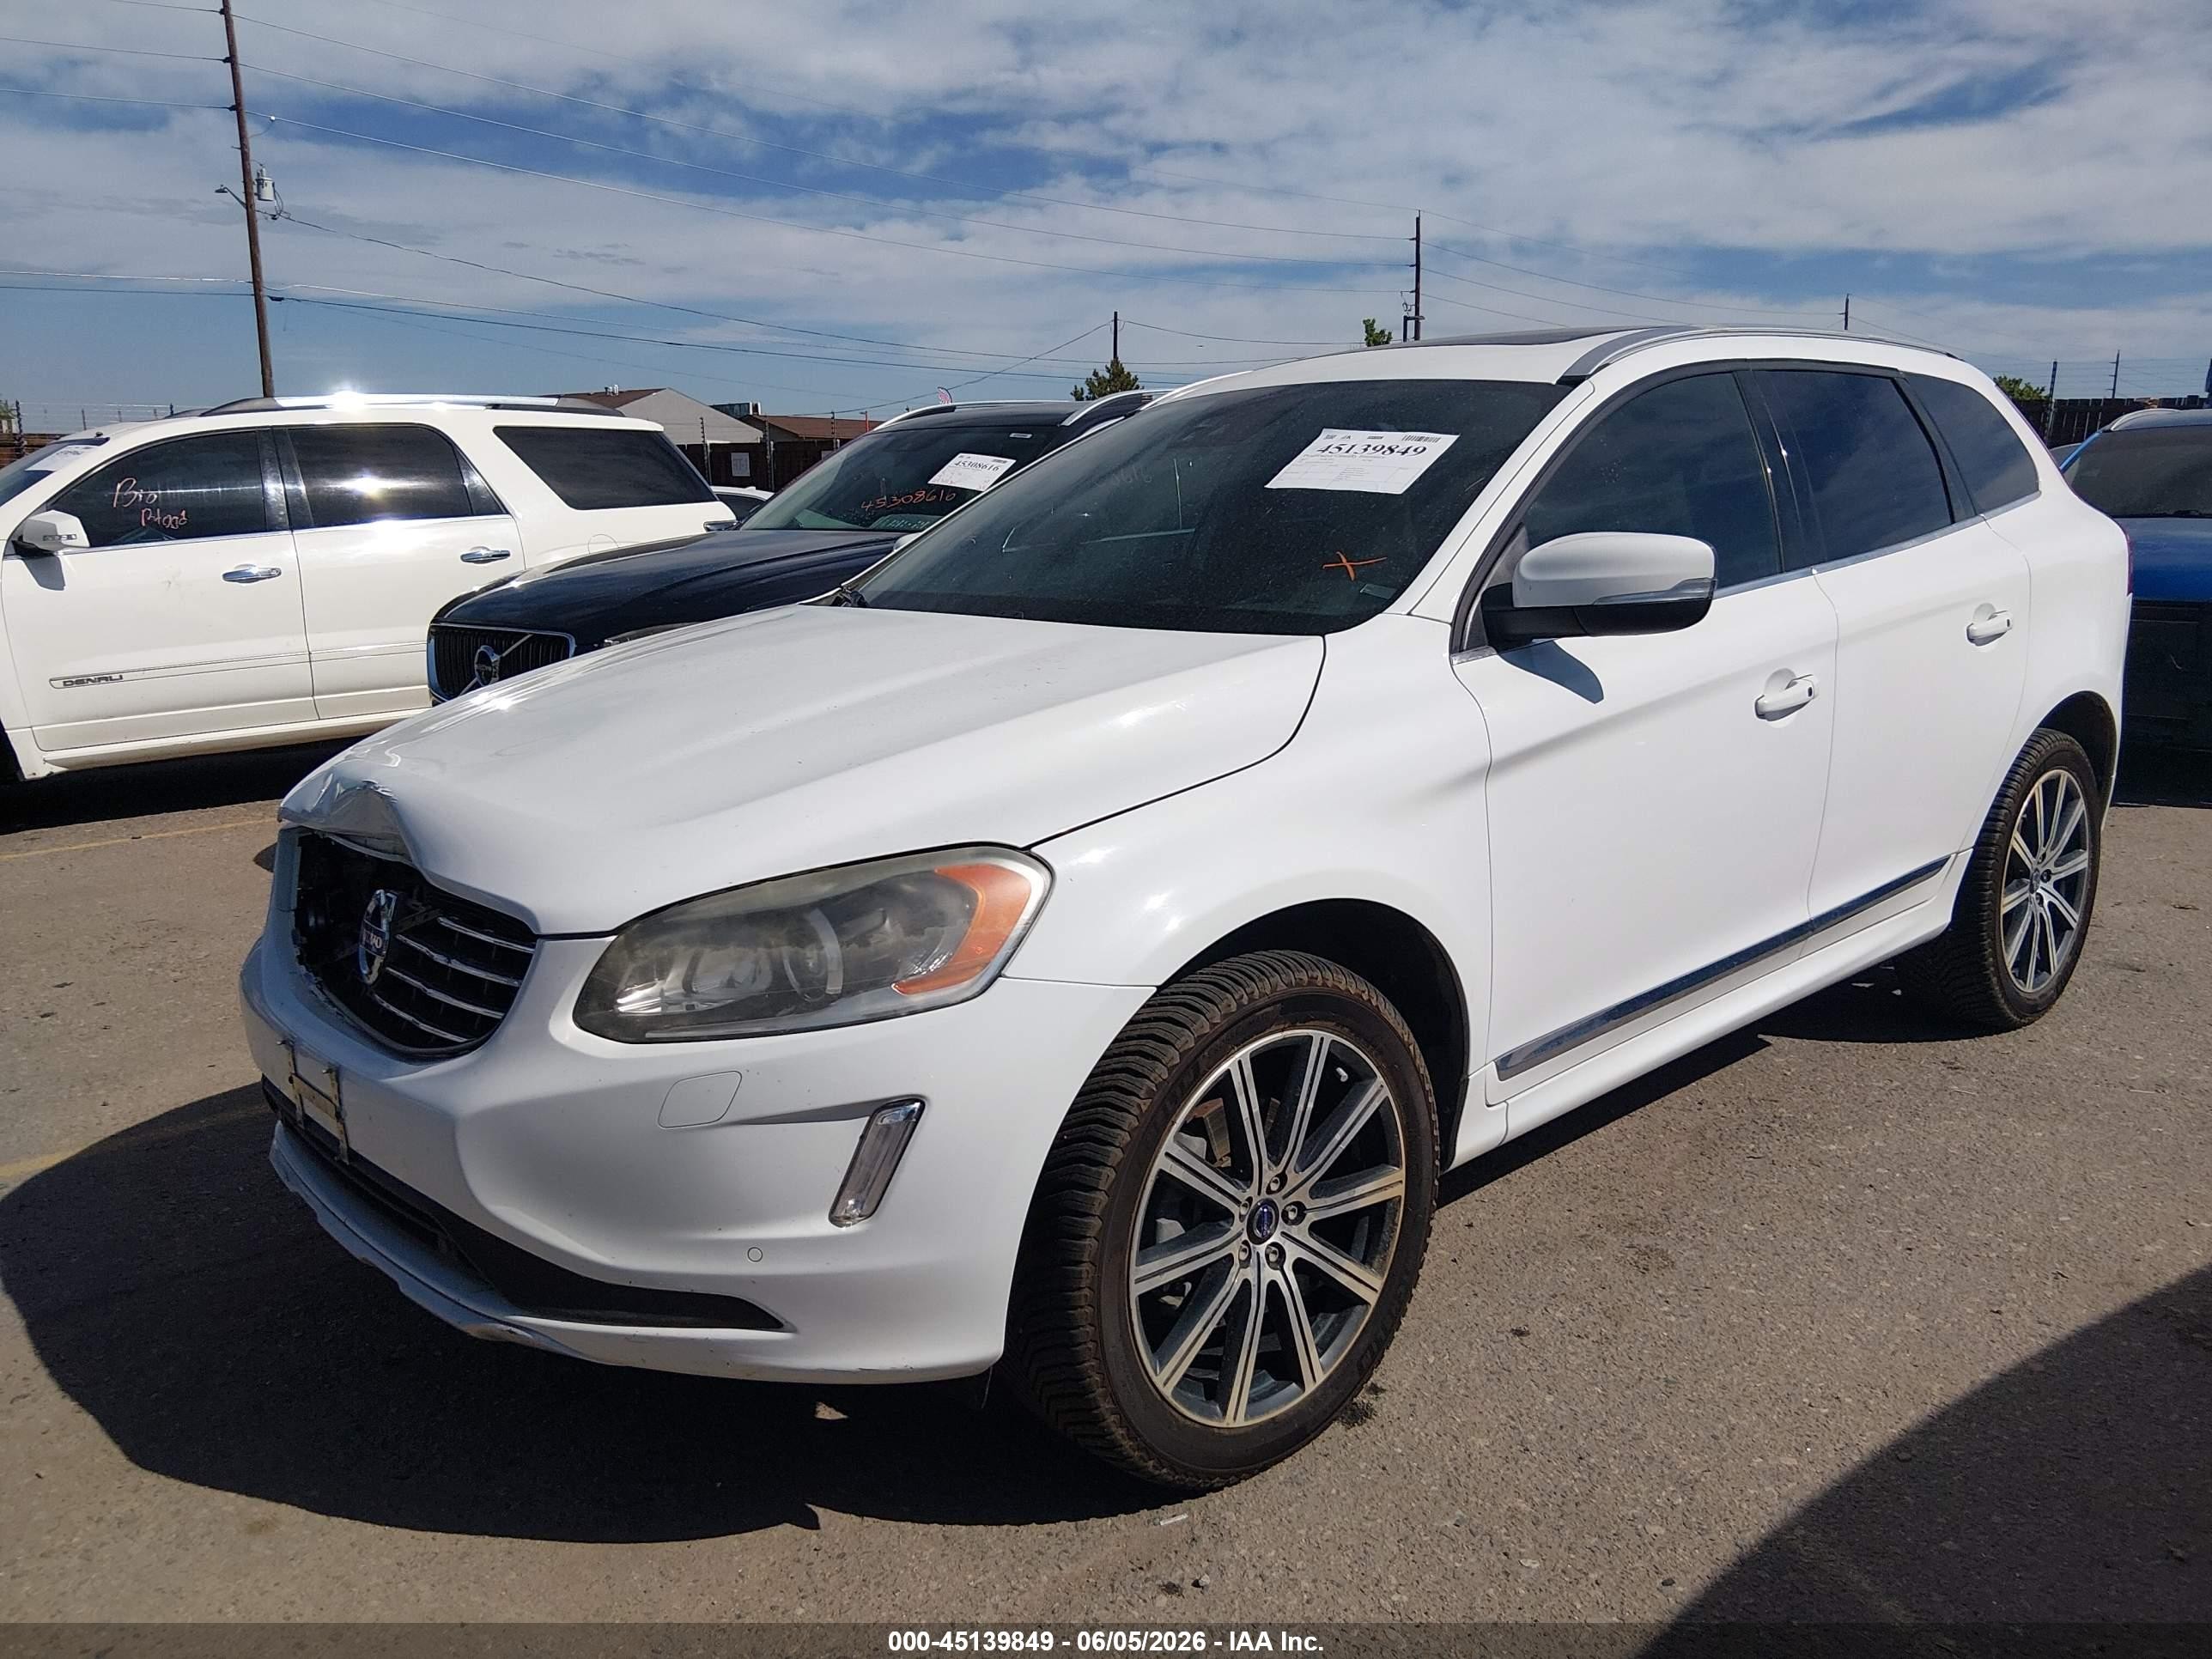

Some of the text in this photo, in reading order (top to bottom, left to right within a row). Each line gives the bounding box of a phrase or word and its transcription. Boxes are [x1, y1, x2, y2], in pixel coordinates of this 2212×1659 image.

[1316, 443, 1427, 457] 45139849
[954, 459, 1000, 472] 45308616
[113, 477, 158, 507] Bio
[63, 674, 123, 687] DENALI
